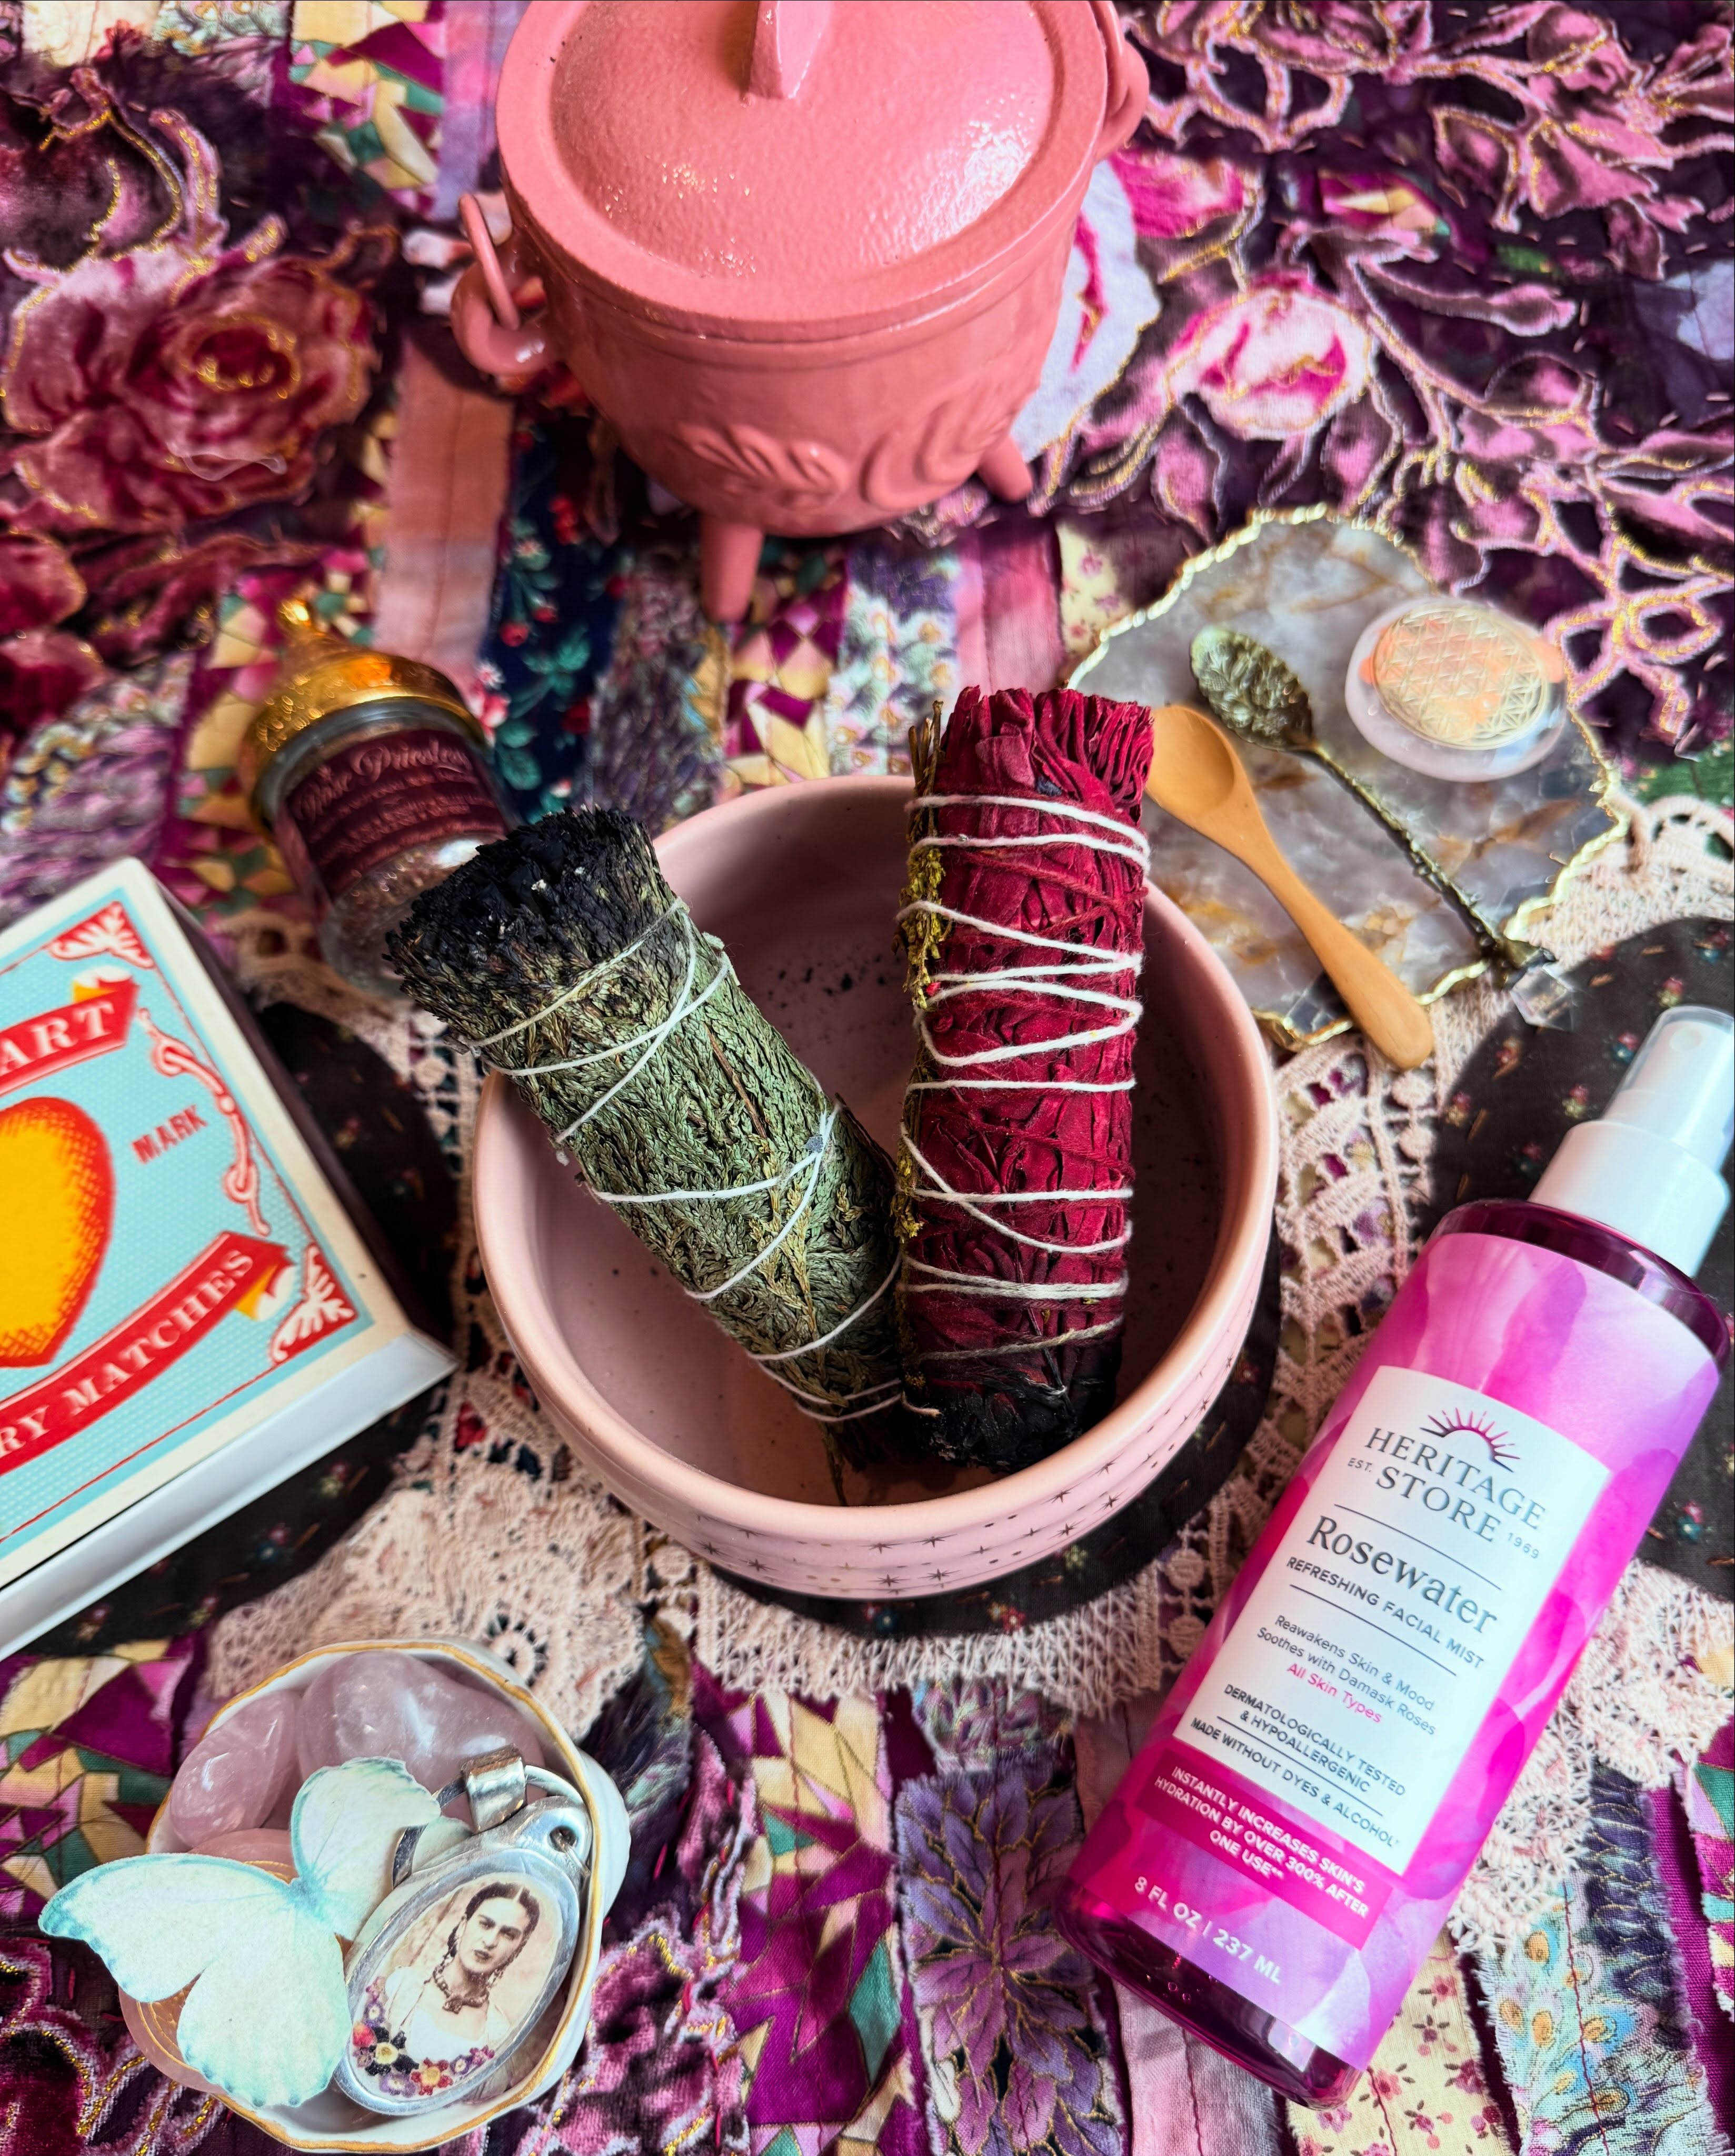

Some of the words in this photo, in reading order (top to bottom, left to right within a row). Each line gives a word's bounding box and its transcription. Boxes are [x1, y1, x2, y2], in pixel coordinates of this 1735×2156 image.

[132, 1105, 206, 1163] MARK
[61, 1250, 253, 1416] MATCHES
[1348, 1458, 1372, 1473] EST.
[1375, 1466, 1501, 1542] STORE
[1507, 1532, 1540, 1559] 1969
[1364, 1428, 1546, 1530] HERITAGE
[1287, 1556, 1380, 1605] REFRESHING
[1382, 1601, 1441, 1643] FACIAL
[1446, 1638, 1484, 1669] MIST
[1307, 1515, 1497, 1633] Rosewater
[1257, 1627, 1303, 1658] Soothes
[1308, 1651, 1335, 1674] with
[1338, 1668, 1394, 1709] Damask
[1397, 1703, 1435, 1735] Roses
[1275, 1615, 1345, 1658] Reawakens
[1349, 1653, 1379, 1678] Skin
[1382, 1672, 1393, 1685] &
[1396, 1680, 1435, 1711] Mood
[1287, 1663, 1306, 1679] All
[1308, 1672, 1338, 1697] Skin
[1343, 1691, 1382, 1723] Types
[1191, 1718, 1221, 1740] MADE
[1222, 1733, 1281, 1773] WITHOUT
[1282, 1769, 1319, 1798] DYES
[1321, 1793, 1331, 1806] &
[1224, 1684, 1355, 1762] DERMATOLOGICALLY
[1359, 1759, 1406, 1796] TESTED
[1240, 1710, 1249, 1721] &
[1251, 1715, 1371, 1793] HYPOALLERGENIC
[1154, 1776, 1222, 1823] HYDRATION
[1221, 1816, 1243, 1834] BY
[1243, 1830, 1285, 1863] OVER
[1285, 1855, 1327, 1889] 300%
[1325, 1883, 1370, 1918] AFTER
[1172, 1766, 1238, 1812] INSTANTLY
[1238, 1805, 1320, 1862] INCREASES
[1319, 1856, 1365, 1893] SKIN'S
[1210, 1830, 1241, 1857] ONE
[1134, 1876, 1148, 1893] 8
[1148, 1885, 1168, 1910] FL
[1173, 1902, 1202, 1928] OZ
[1213, 1929, 1253, 1960] 237
[1253, 1954, 1281, 1984] ML
